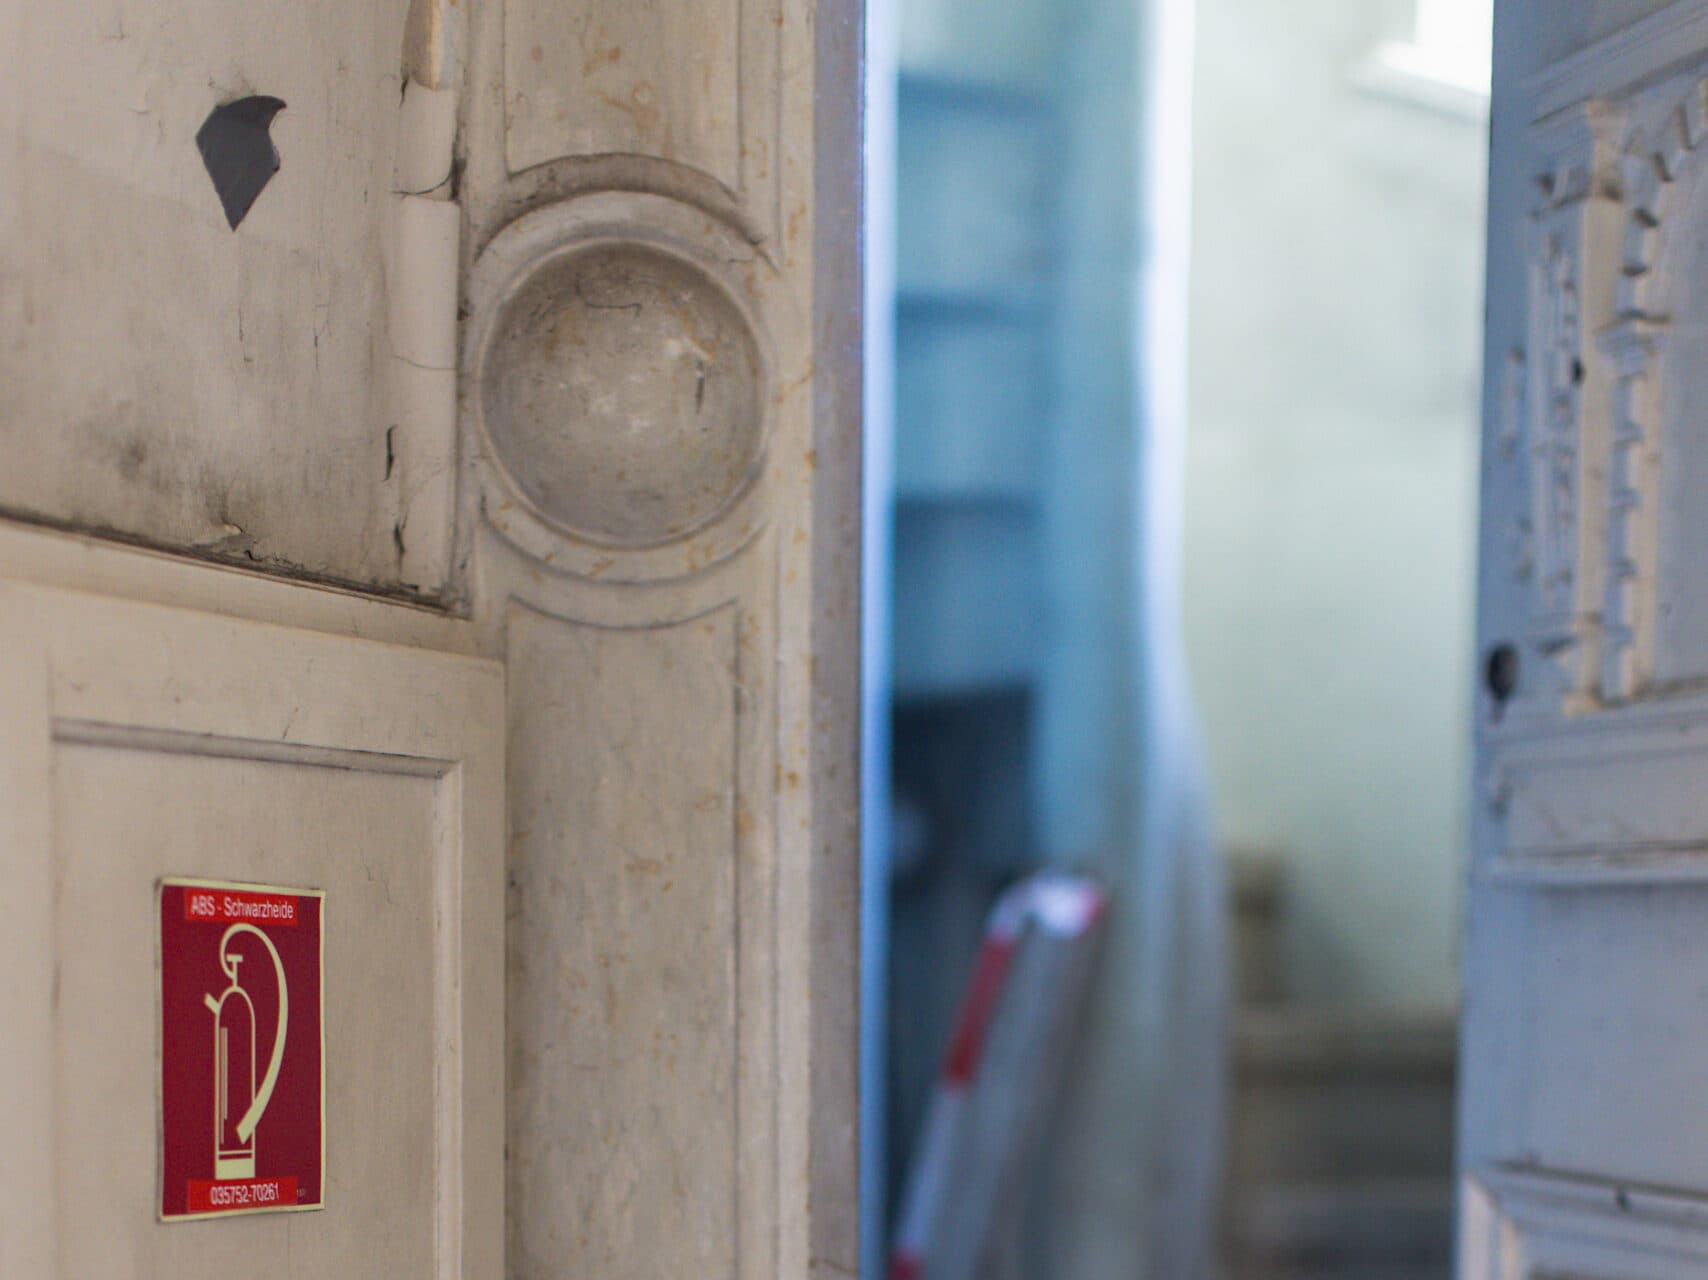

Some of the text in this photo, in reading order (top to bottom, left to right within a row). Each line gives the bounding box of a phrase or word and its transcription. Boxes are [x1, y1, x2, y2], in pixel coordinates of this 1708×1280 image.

[192, 896, 215, 916] ABS
[224, 897, 293, 919] Schwarzheide
[211, 1183, 279, 1204] 035752-70261
